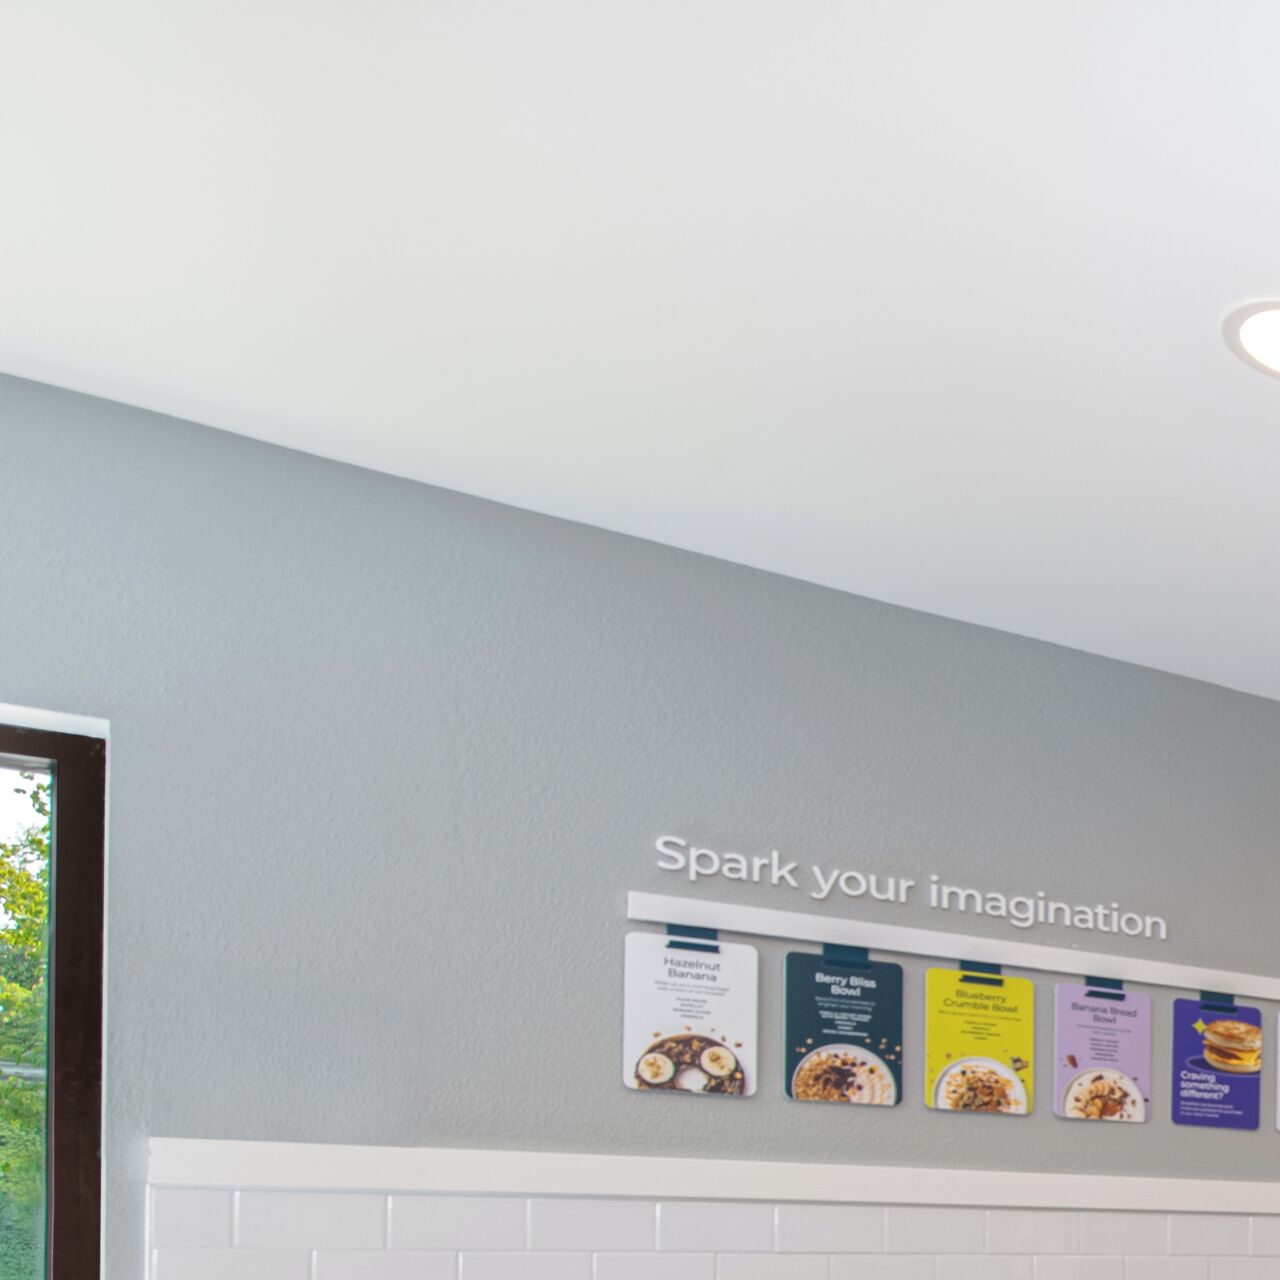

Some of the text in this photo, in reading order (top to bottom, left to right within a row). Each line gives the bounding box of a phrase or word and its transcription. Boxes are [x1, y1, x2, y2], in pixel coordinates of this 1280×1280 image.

[655, 835, 1168, 940] Spark your imagination
[663, 957, 721, 972] Hazelnut
[668, 968, 717, 982] Banana
[815, 972, 877, 988] Berry Bliss
[831, 985, 861, 996] Bowl
[955, 989, 1007, 1004] Blueberry
[943, 998, 1018, 1013] Crumble Bowl
[1071, 1002, 1137, 1018] Banana Bread
[1093, 1014, 1117, 1024] Bowl
[1180, 1070, 1216, 1083] Craving
[1180, 1081, 1230, 1094] something
[1180, 1089, 1224, 1100] different?
